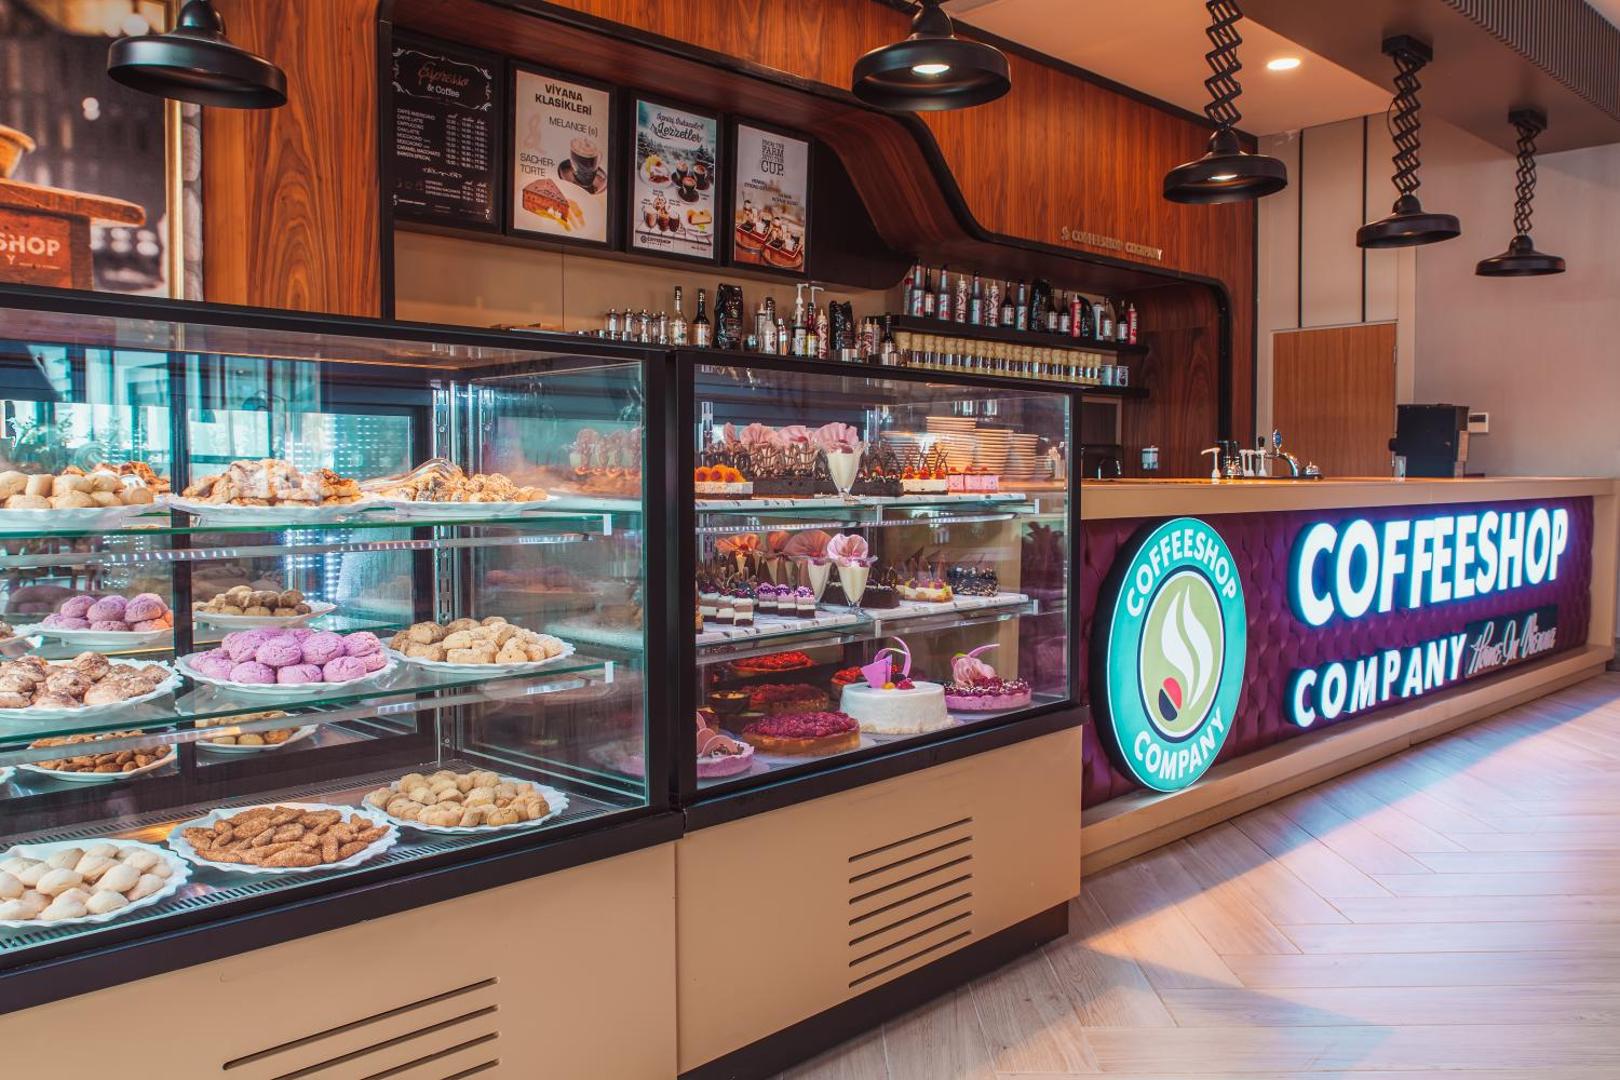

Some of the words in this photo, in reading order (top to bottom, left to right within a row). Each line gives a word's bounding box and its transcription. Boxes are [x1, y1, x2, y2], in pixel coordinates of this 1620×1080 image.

[435, 85, 460, 98] Coffee
[545, 84, 583, 102] VİYANA
[535, 93, 592, 116] KLASİKLERİ
[549, 116, 587, 134] MELANGE
[650, 122, 705, 143] Lezzetler
[762, 146, 785, 159] FARM
[519, 164, 545, 177] TORTE
[1126, 528, 1237, 617] COFFEESHOP
[1297, 507, 1569, 626] COFFEESHOP
[1293, 633, 1468, 728] COMPANY
[1134, 706, 1225, 780] COMPANY
